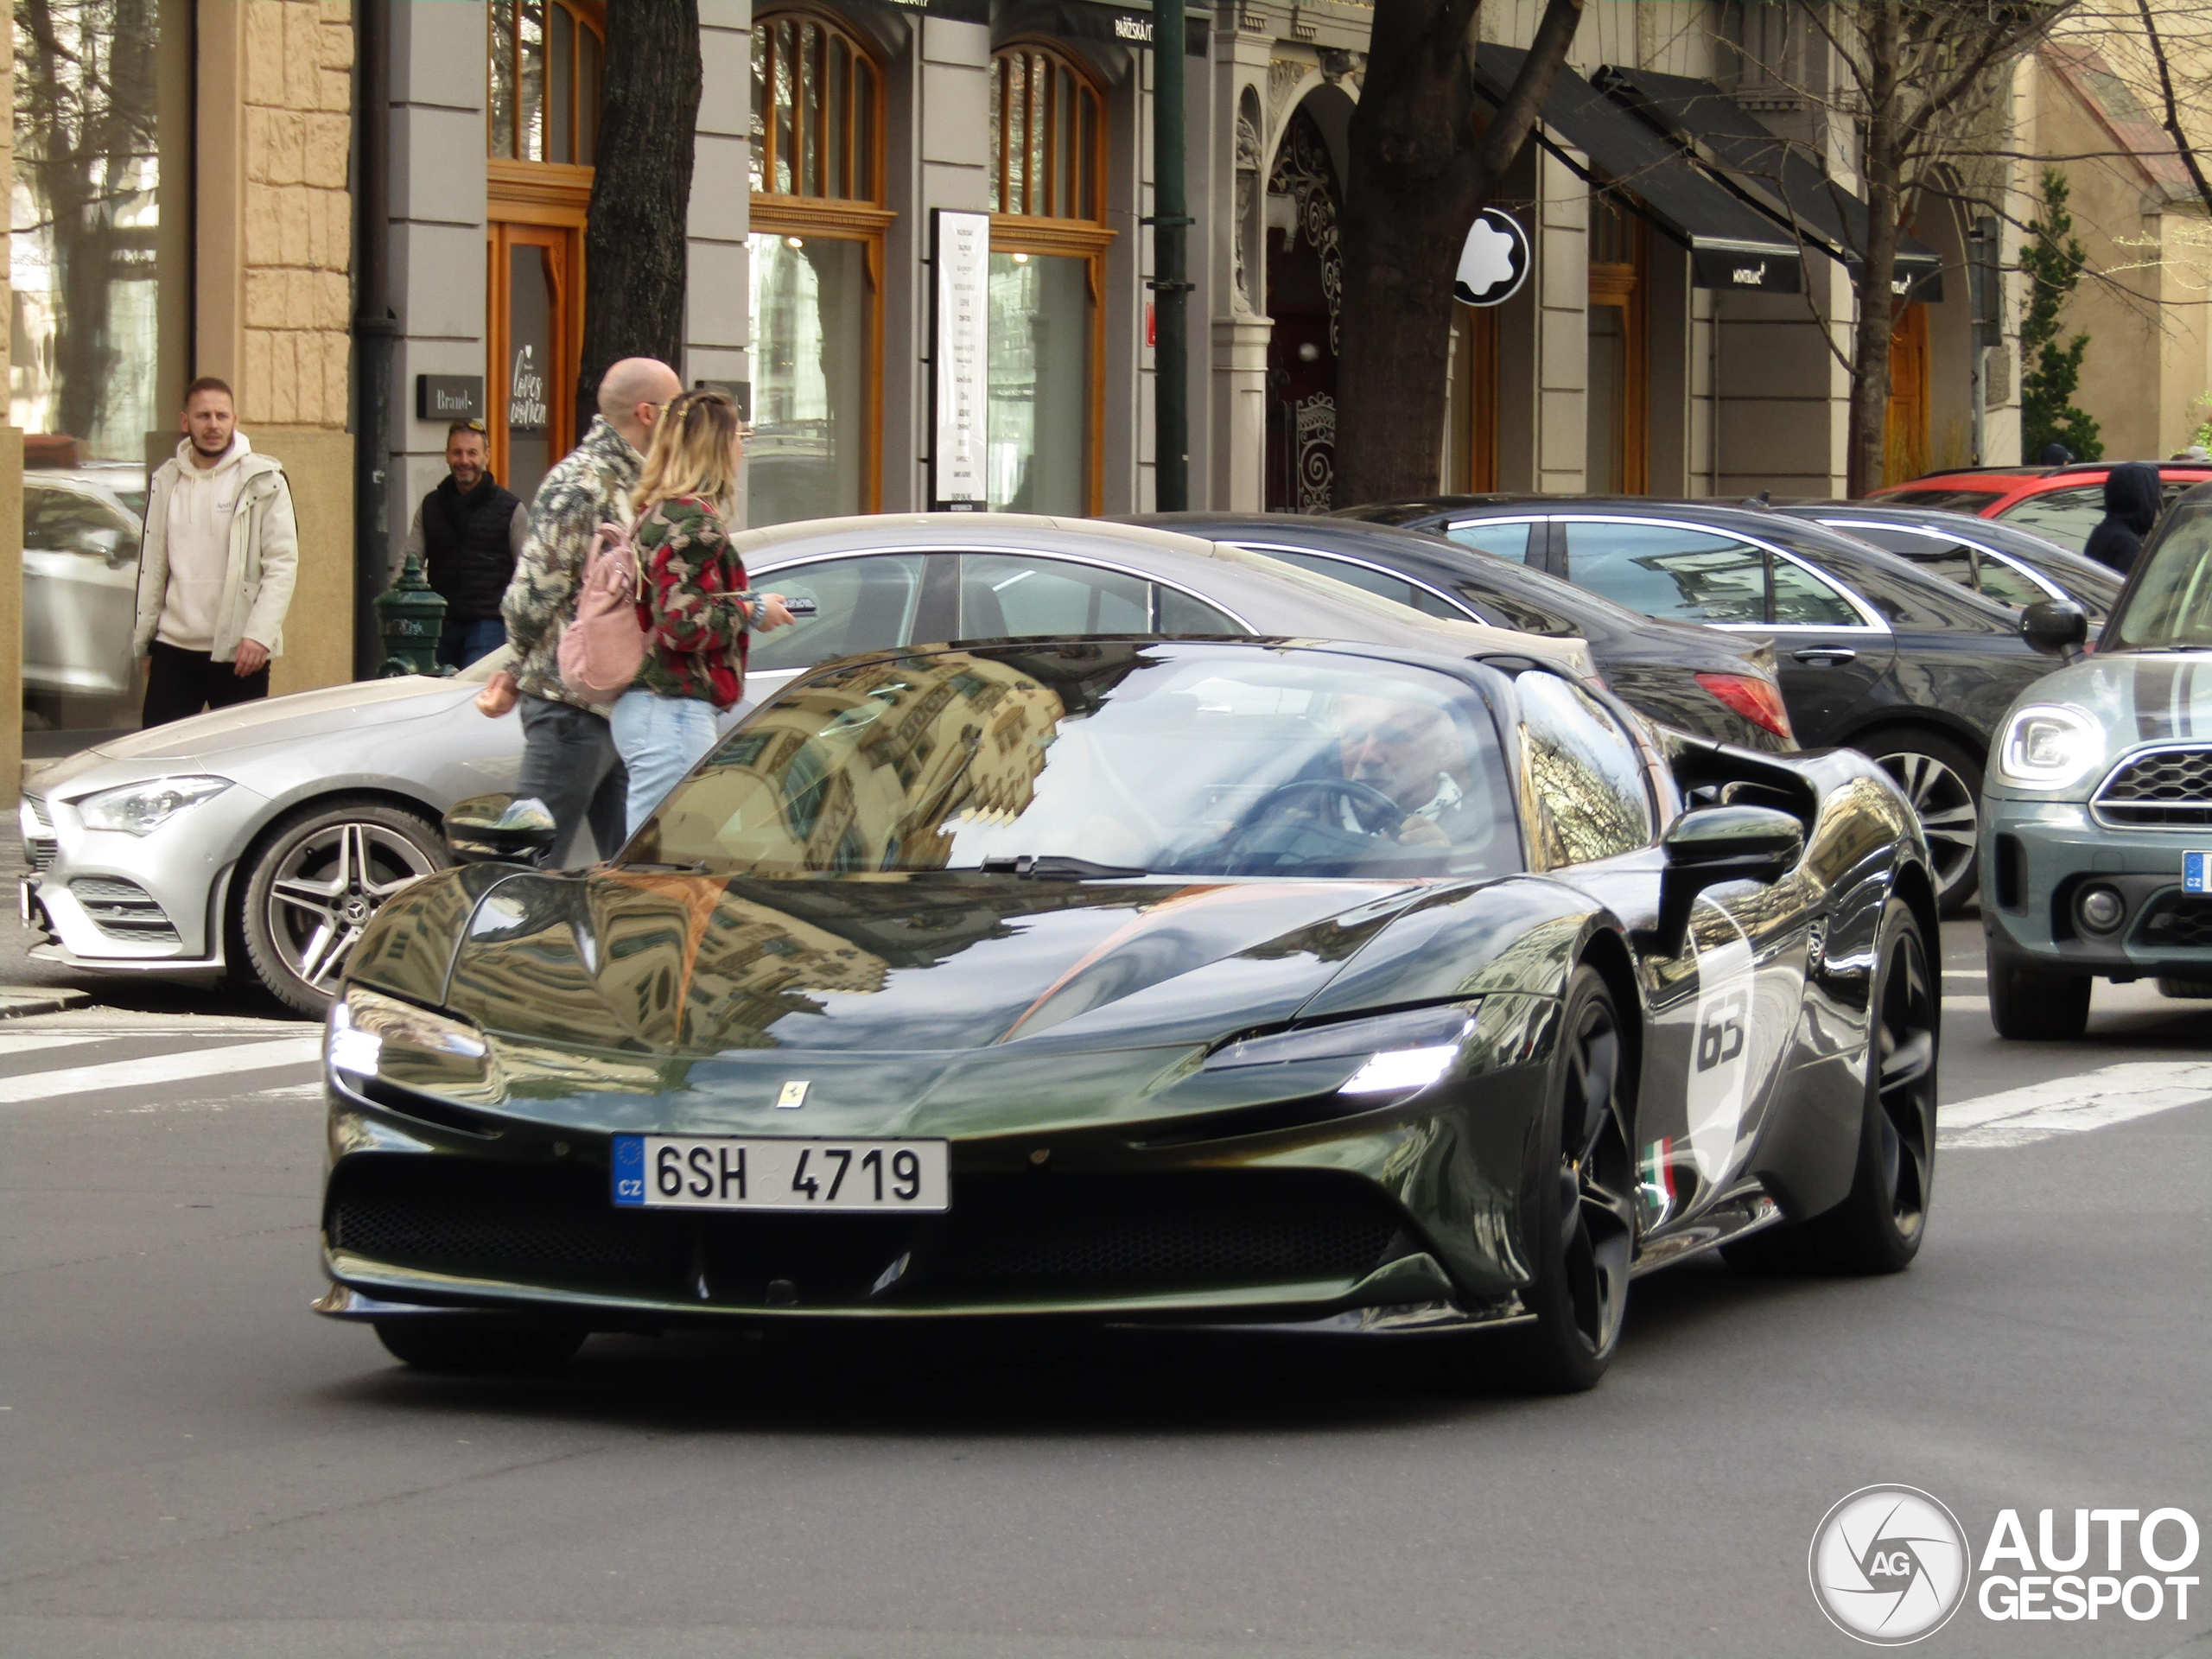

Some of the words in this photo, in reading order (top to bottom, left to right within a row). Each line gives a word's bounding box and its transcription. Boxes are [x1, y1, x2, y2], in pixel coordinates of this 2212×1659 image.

[2187, 877, 2202, 887] CZ
[1697, 987, 1749, 1073] 65
[618, 1179, 642, 1197] CZ
[658, 1146, 746, 1199] 6SH
[792, 1147, 920, 1201] 4719
